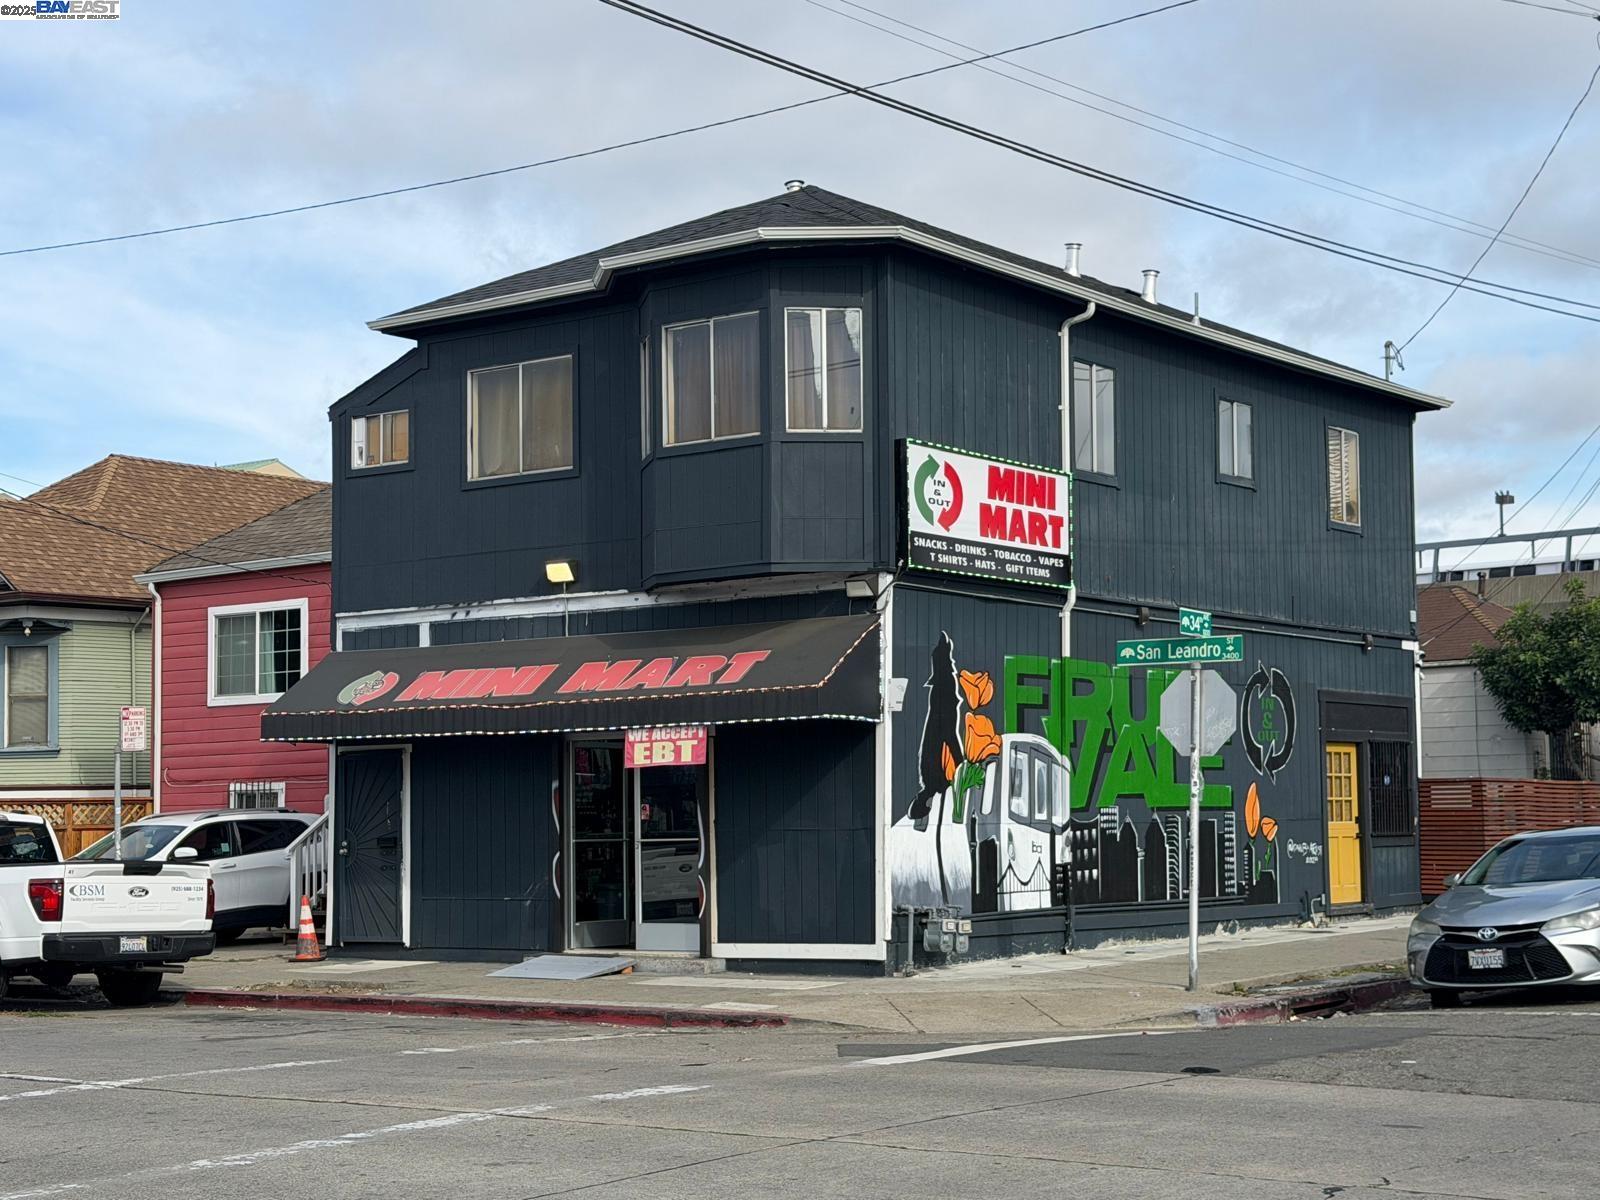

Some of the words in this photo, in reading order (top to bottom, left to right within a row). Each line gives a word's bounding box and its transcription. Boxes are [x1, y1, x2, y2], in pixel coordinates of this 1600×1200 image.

[933, 479, 946, 487] IN
[987, 465, 1056, 510] MINI
[928, 498, 951, 507] OUT
[979, 502, 1064, 549] MART
[913, 536, 948, 551] SNACKS
[954, 543, 987, 557] DRINKS
[993, 549, 1032, 563] TOBACCO
[1038, 555, 1064, 568] VAPES
[929, 552, 936, 562] T
[937, 553, 968, 567] SHIRTS
[974, 558, 996, 570] HATS
[1005, 563, 1024, 574] GIFT
[1026, 566, 1050, 578] ITEMS
[1136, 644, 1161, 660] San
[1167, 642, 1221, 659] Leandro
[1222, 652, 1240, 660] 3400
[393, 663, 560, 702] MINI
[556, 649, 772, 694] MART
[1260, 697, 1276, 711] IN
[628, 728, 650, 742] WE
[652, 725, 704, 741] ACCEPT
[1257, 730, 1281, 742] OUT
[634, 740, 699, 765] EBT
[79, 885, 105, 896] BSM
